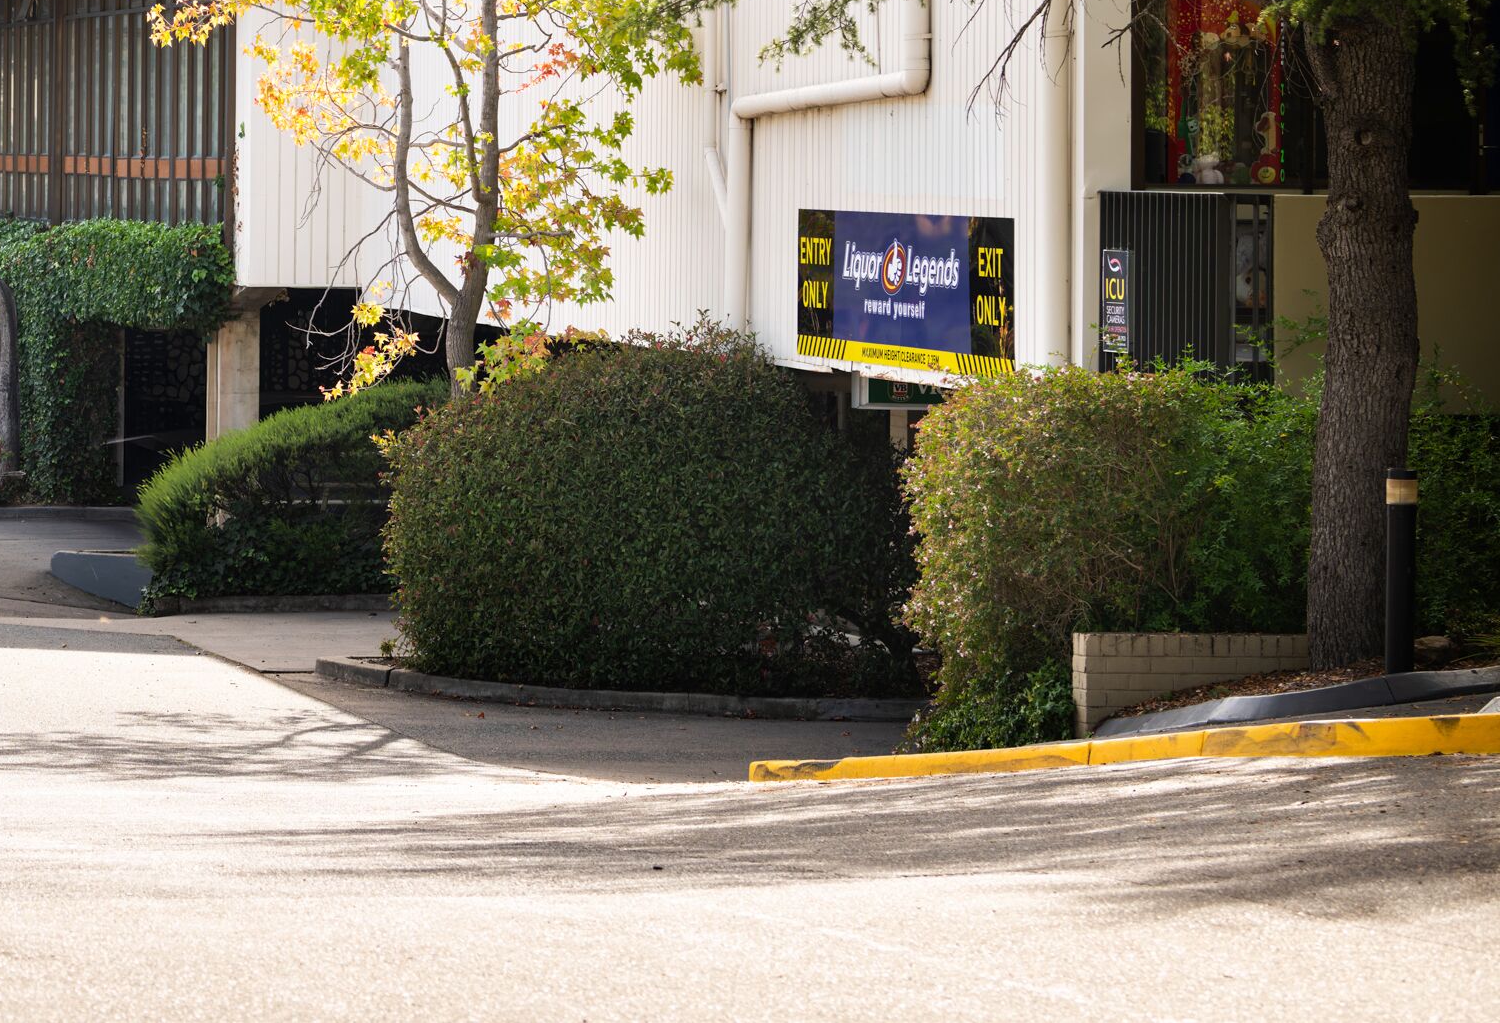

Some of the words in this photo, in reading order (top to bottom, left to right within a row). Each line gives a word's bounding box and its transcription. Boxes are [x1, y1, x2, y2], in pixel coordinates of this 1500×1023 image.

[800, 236, 832, 266] ENTRY
[977, 246, 1004, 278] EXIT
[842, 241, 883, 290] Liquor
[905, 245, 960, 296] Legends
[802, 280, 829, 310] ONLY
[1105, 278, 1125, 300] ICU
[864, 297, 892, 316] reward
[893, 300, 926, 320] yourself
[976, 295, 1007, 326] ONLY
[1106, 305, 1125, 315] SECURITY
[1106, 314, 1125, 325] CAMERAS
[861, 346, 884, 360] MAXIMUM
[884, 349, 901, 362] HEIGHT
[901, 350, 926, 365] CLEARANCE
